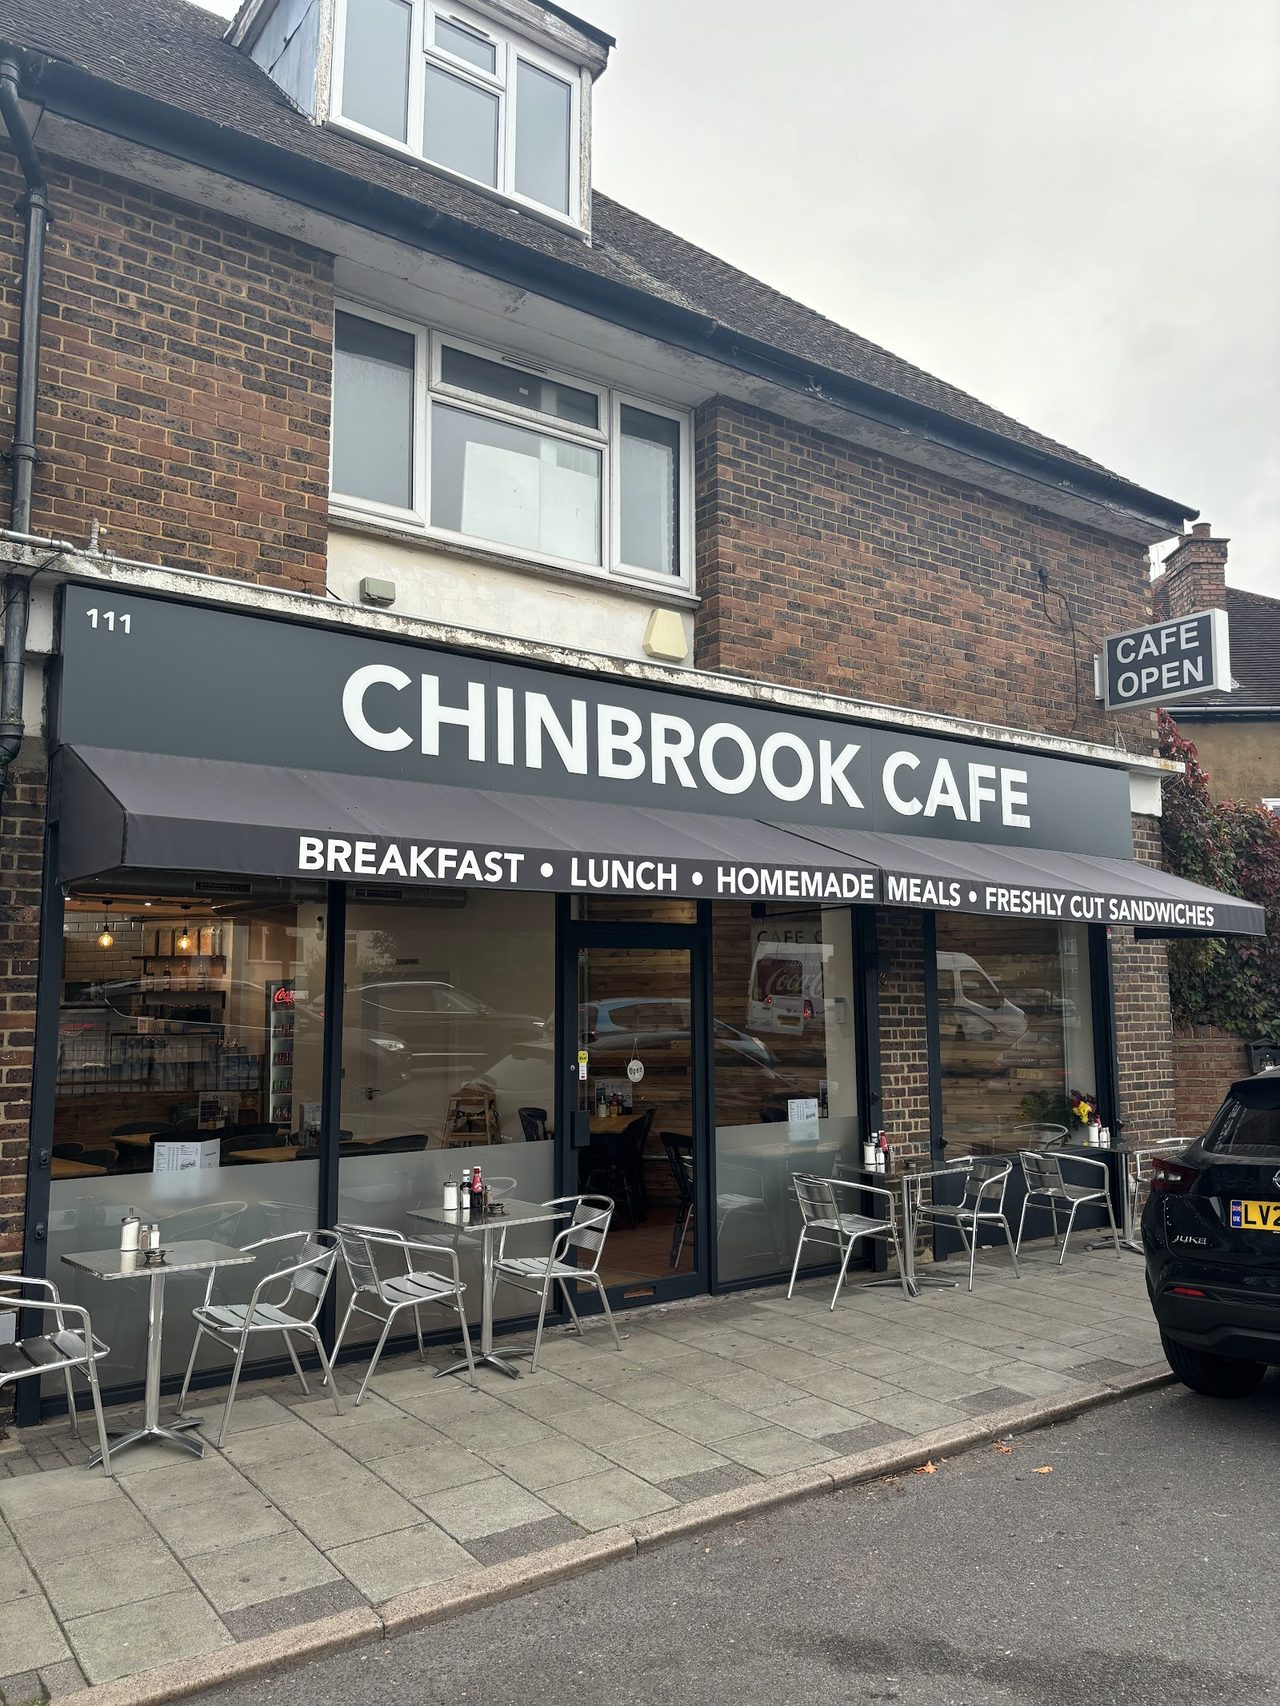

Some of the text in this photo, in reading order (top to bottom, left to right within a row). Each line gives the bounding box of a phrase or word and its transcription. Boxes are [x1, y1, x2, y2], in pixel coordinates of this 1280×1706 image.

[86, 608, 132, 634] 111
[1116, 621, 1200, 664] CAFE
[1117, 655, 1204, 698] OPEN
[342, 664, 1031, 829] CHINBROOK CAFE
[298, 836, 1215, 927] BREAKFAST LUNCH HOMEMADE MEALS FRESHLY CUT SANDWICHES
[1171, 1234, 1207, 1245] JUKE
